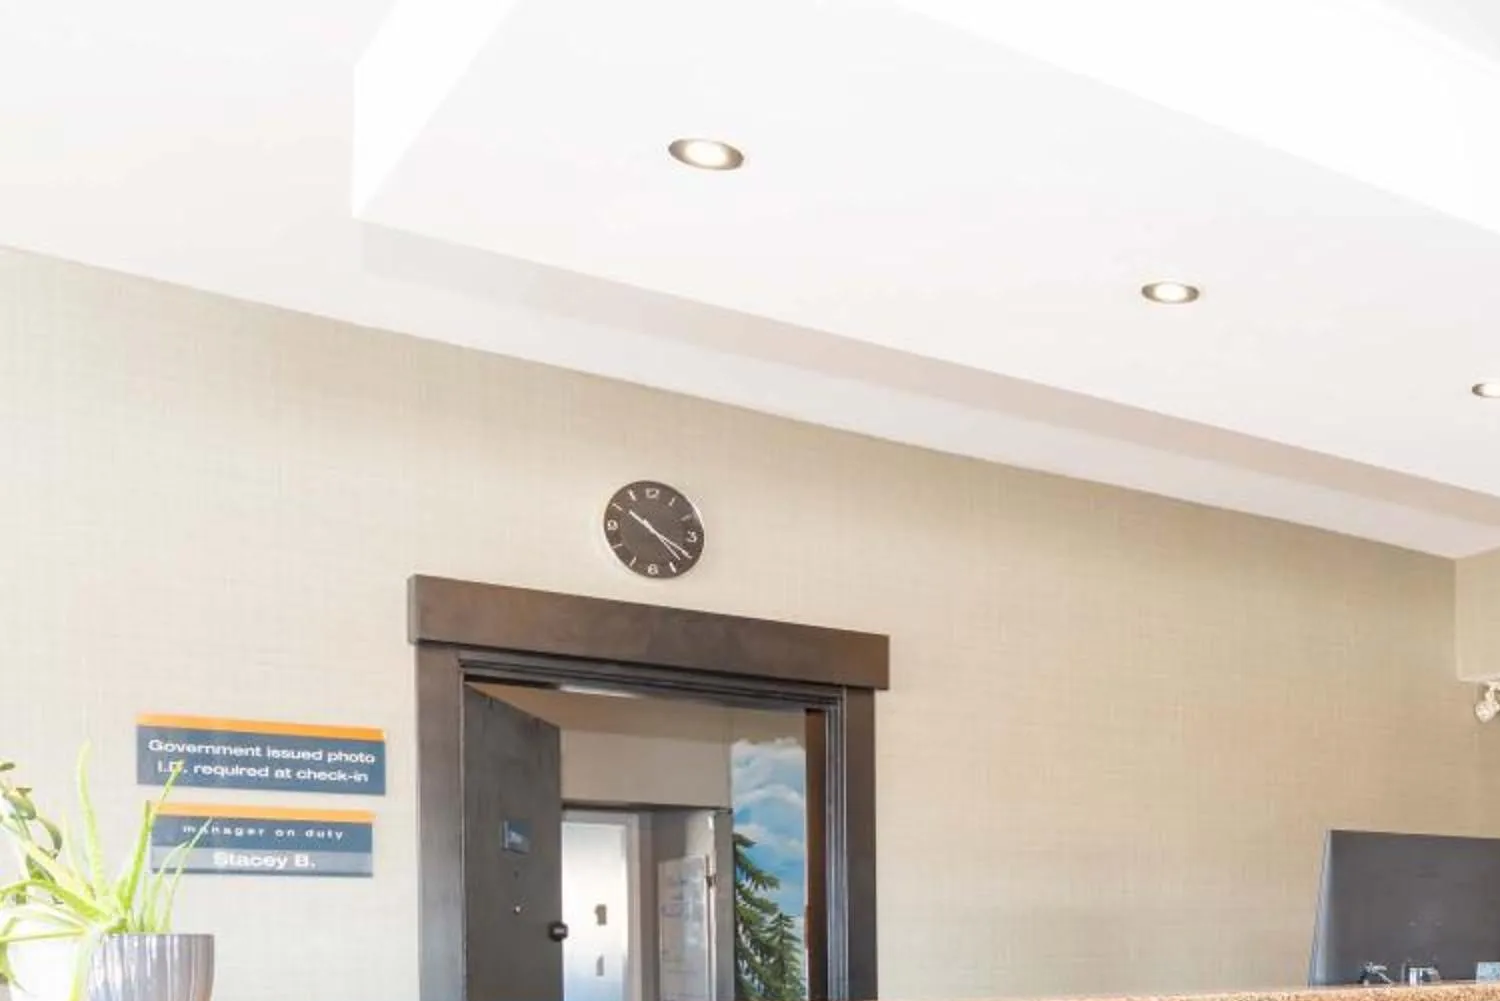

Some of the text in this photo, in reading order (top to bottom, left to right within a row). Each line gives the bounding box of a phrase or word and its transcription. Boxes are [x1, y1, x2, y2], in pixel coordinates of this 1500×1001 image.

[147, 739, 376, 765] Government issued photo
[193, 765, 269, 779] required
[275, 767, 292, 779] at
[296, 767, 369, 783] check-in
[275, 829, 296, 837] on
[305, 829, 343, 840] duty
[213, 851, 316, 870] Stacey B.
